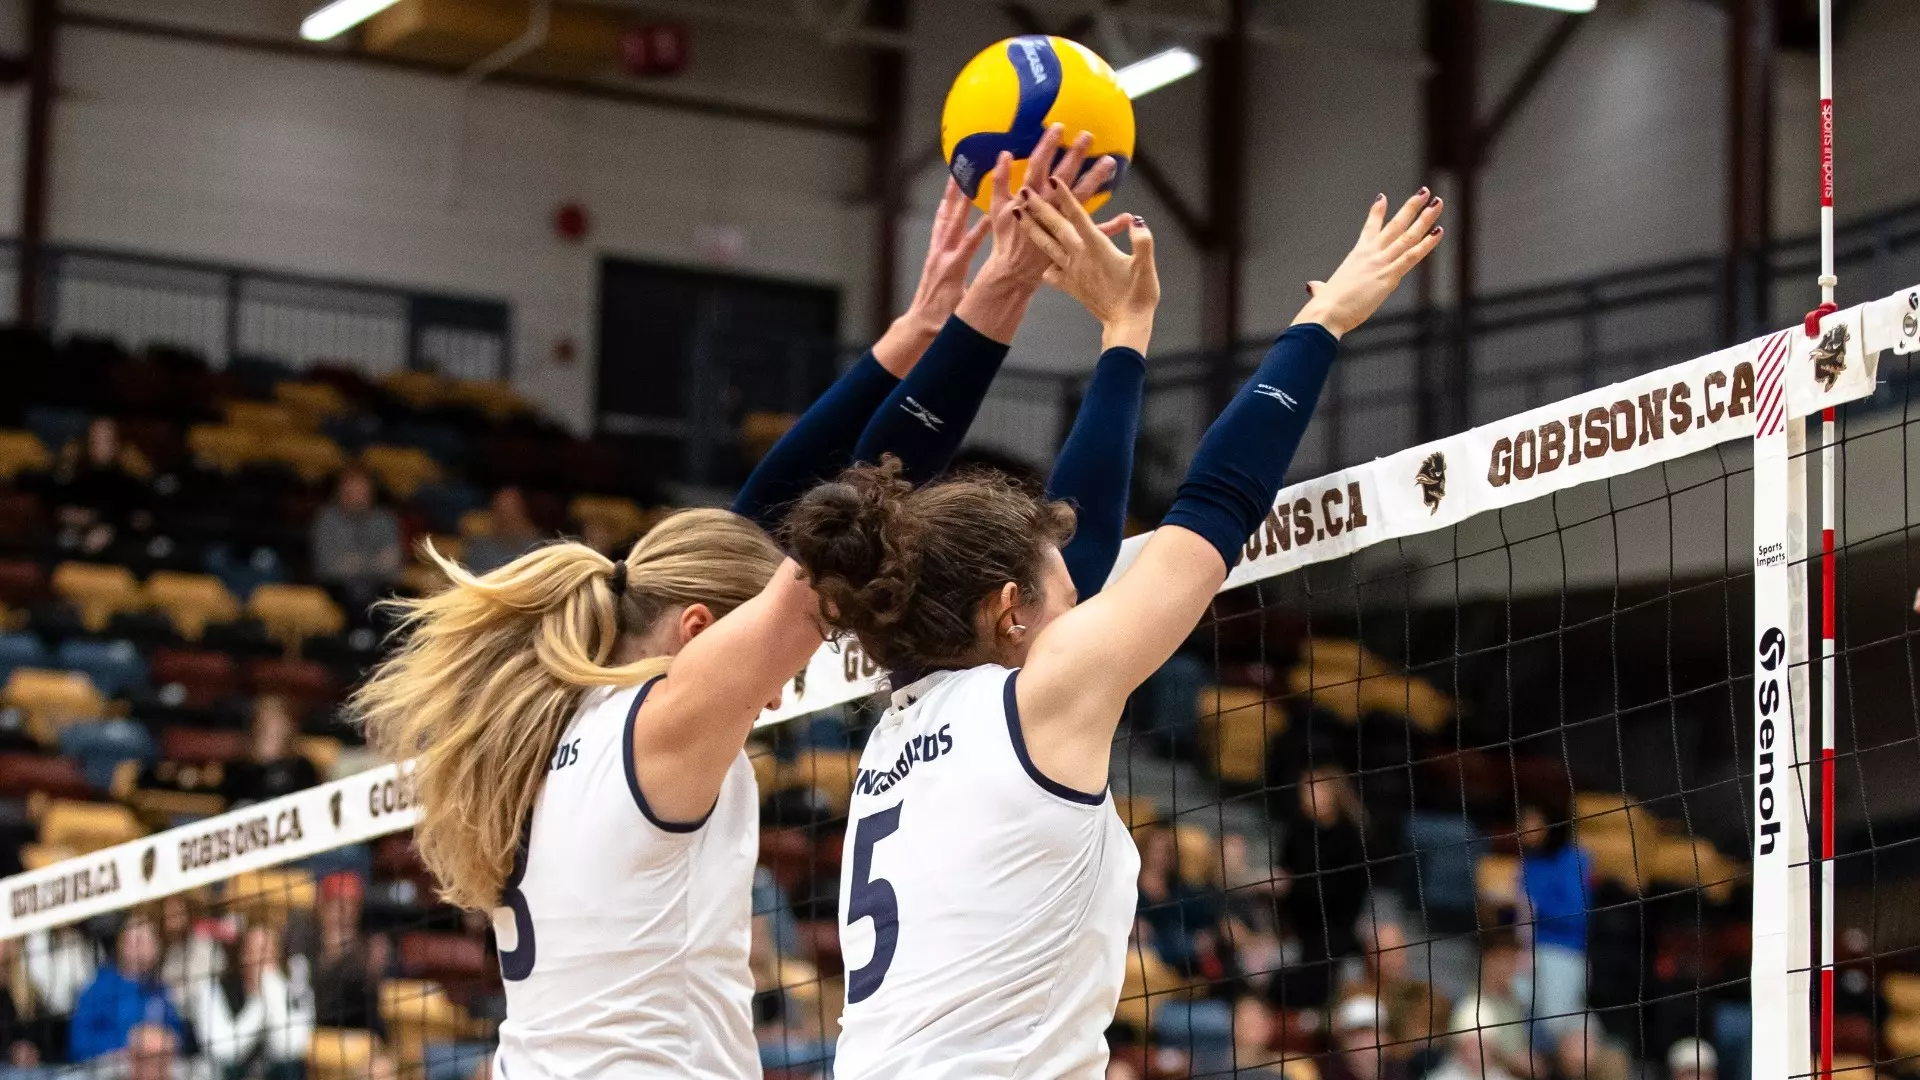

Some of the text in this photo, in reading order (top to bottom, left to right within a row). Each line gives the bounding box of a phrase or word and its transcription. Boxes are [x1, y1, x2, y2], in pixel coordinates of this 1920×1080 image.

[1487, 361, 1755, 488] GOBISONS.CA
[1756, 552, 1786, 567] Imports
[1758, 542, 1783, 557] Sports
[1759, 678, 1781, 856] Senoh
[847, 798, 904, 1005] 5
